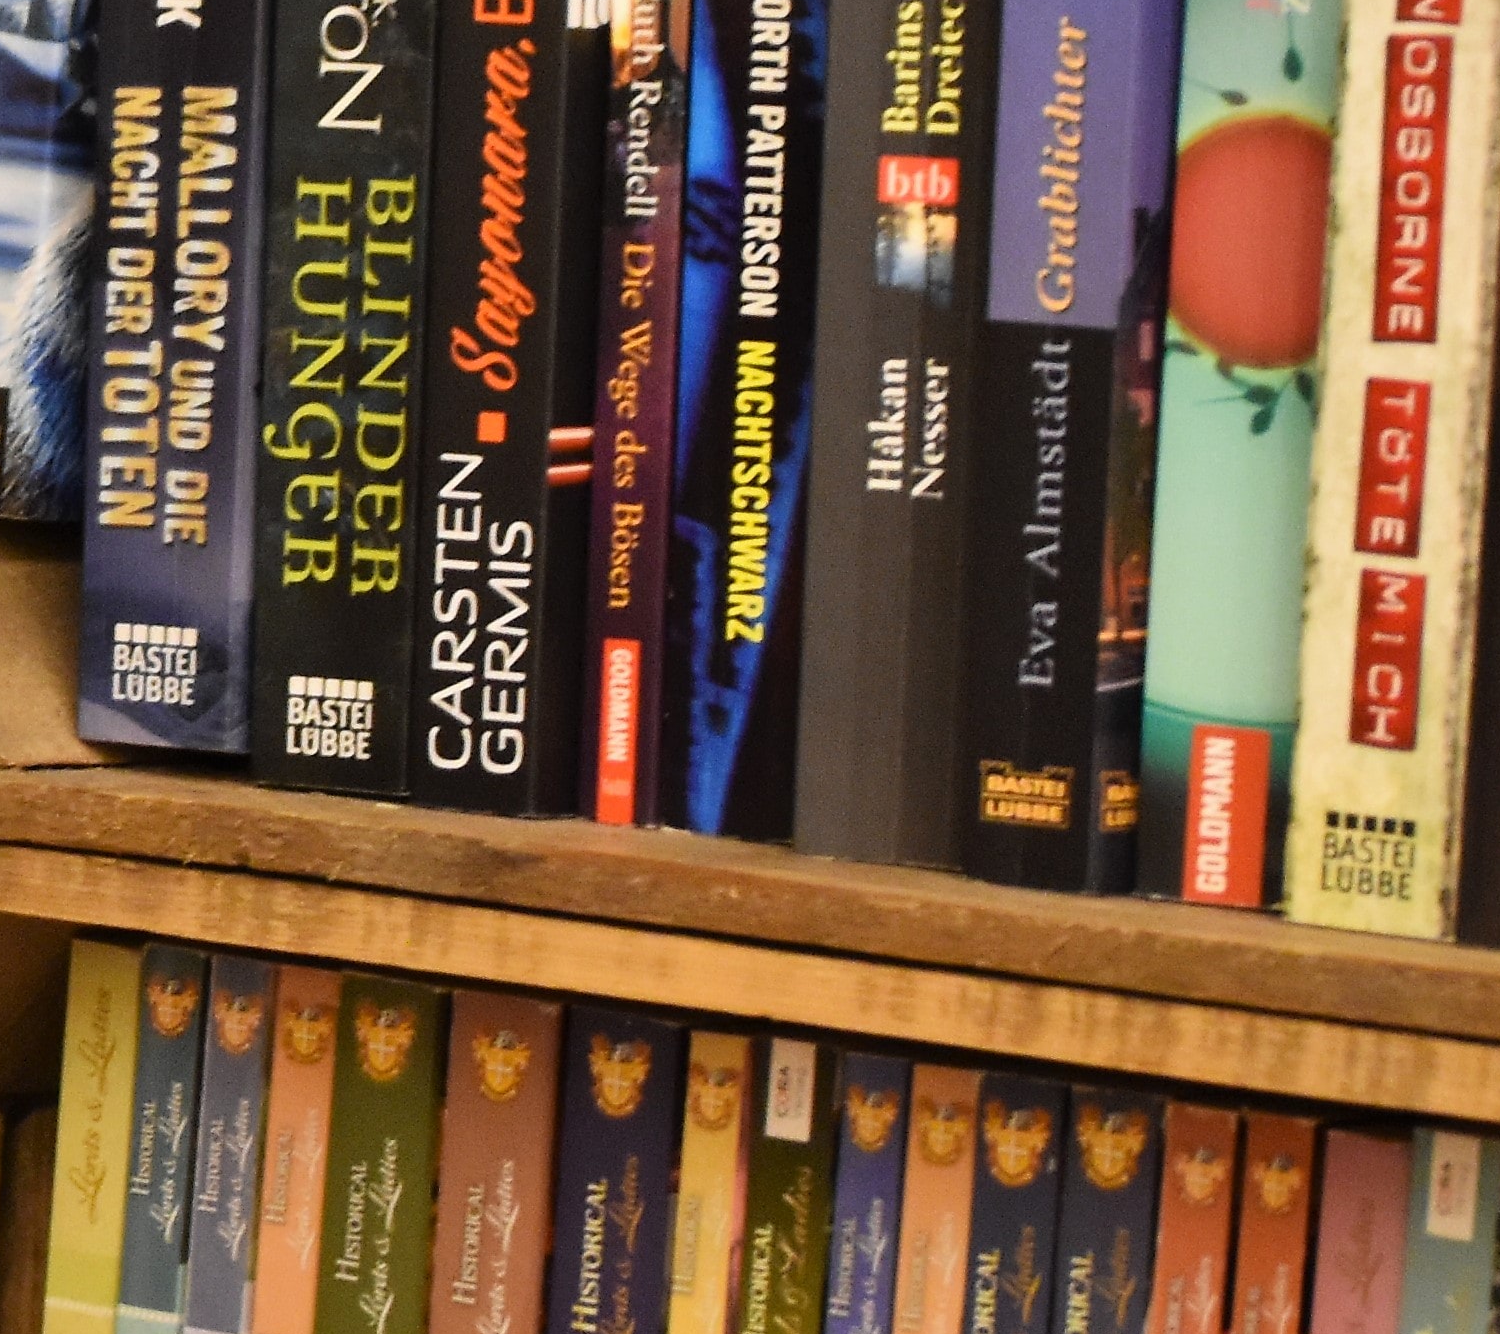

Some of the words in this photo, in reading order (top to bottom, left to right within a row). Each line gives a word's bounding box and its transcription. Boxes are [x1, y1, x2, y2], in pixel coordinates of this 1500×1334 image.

[881, 0, 924, 134] Barins
[109, 87, 162, 237] NACHT
[171, 85, 238, 351] MALLORY
[740, 104, 787, 319] PATTERSON
[1034, 16, 1088, 313] Grablichter
[104, 246, 156, 335] DER
[99, 339, 159, 528] TOTEN
[167, 363, 213, 452] UND
[350, 175, 417, 595] BLINDER
[1024, 338, 1071, 576] Almstädt
[162, 462, 211, 546] DIE
[725, 340, 778, 643] NACHTSCHWARZ
[428, 453, 485, 771] CARSTEN
[481, 520, 535, 775] GERMIS
[1018, 600, 1057, 687] Eva
[112, 673, 196, 705] LÜBBE
[286, 727, 371, 762] LÜBBE
[288, 694, 374, 729] BASTEI
[608, 648, 631, 761] GOLDMANN
[1195, 736, 1236, 894] GOLDMANN
[1324, 834, 1415, 867] BASTEI
[571, 1179, 606, 1334] HISTORICAL
